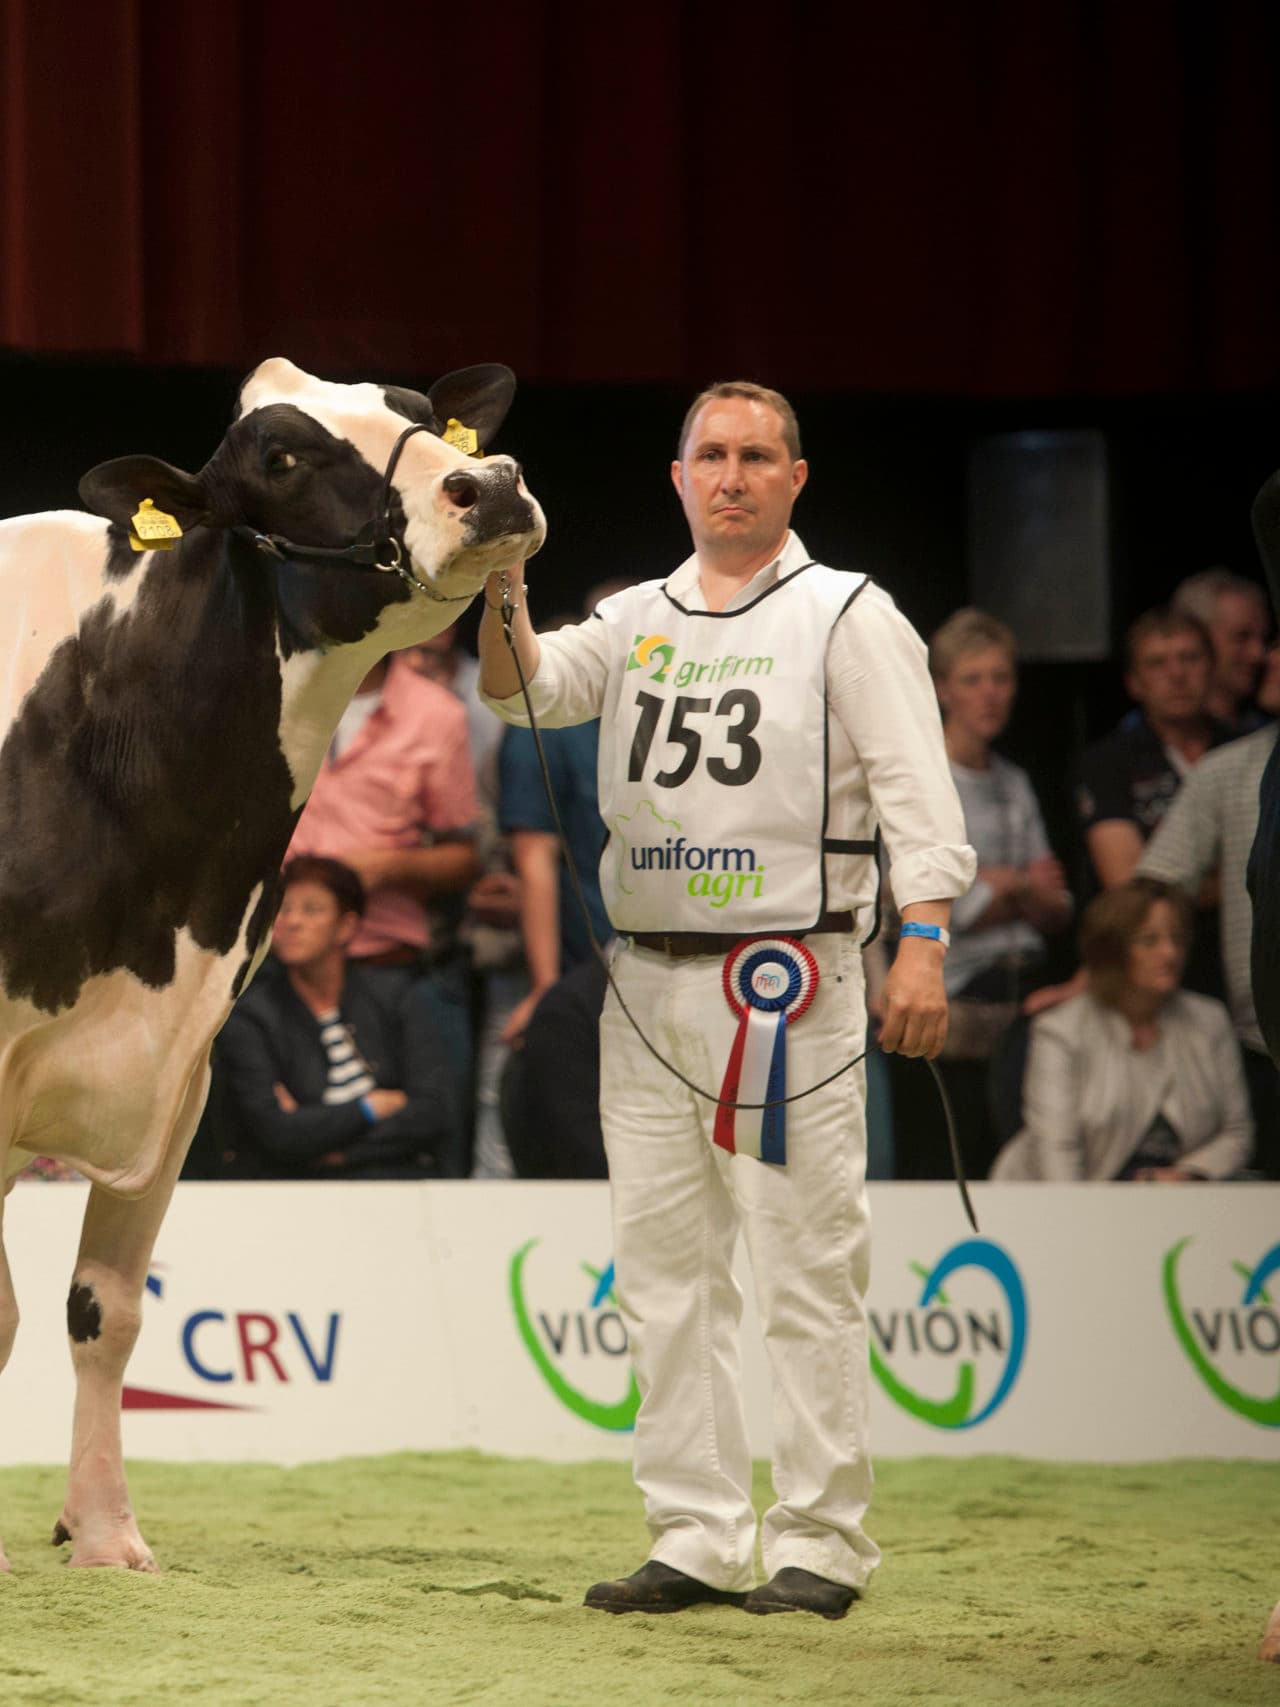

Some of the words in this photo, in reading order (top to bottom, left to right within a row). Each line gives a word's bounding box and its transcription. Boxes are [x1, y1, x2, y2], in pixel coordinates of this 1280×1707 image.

[627, 688, 762, 788] 153
[631, 838, 756, 871] uniform
[687, 865, 764, 908] agri
[182, 1310, 339, 1383] CRV
[539, 1311, 629, 1354] VIO
[870, 1310, 1004, 1354] VION
[1192, 1309, 1280, 1353] VIO
